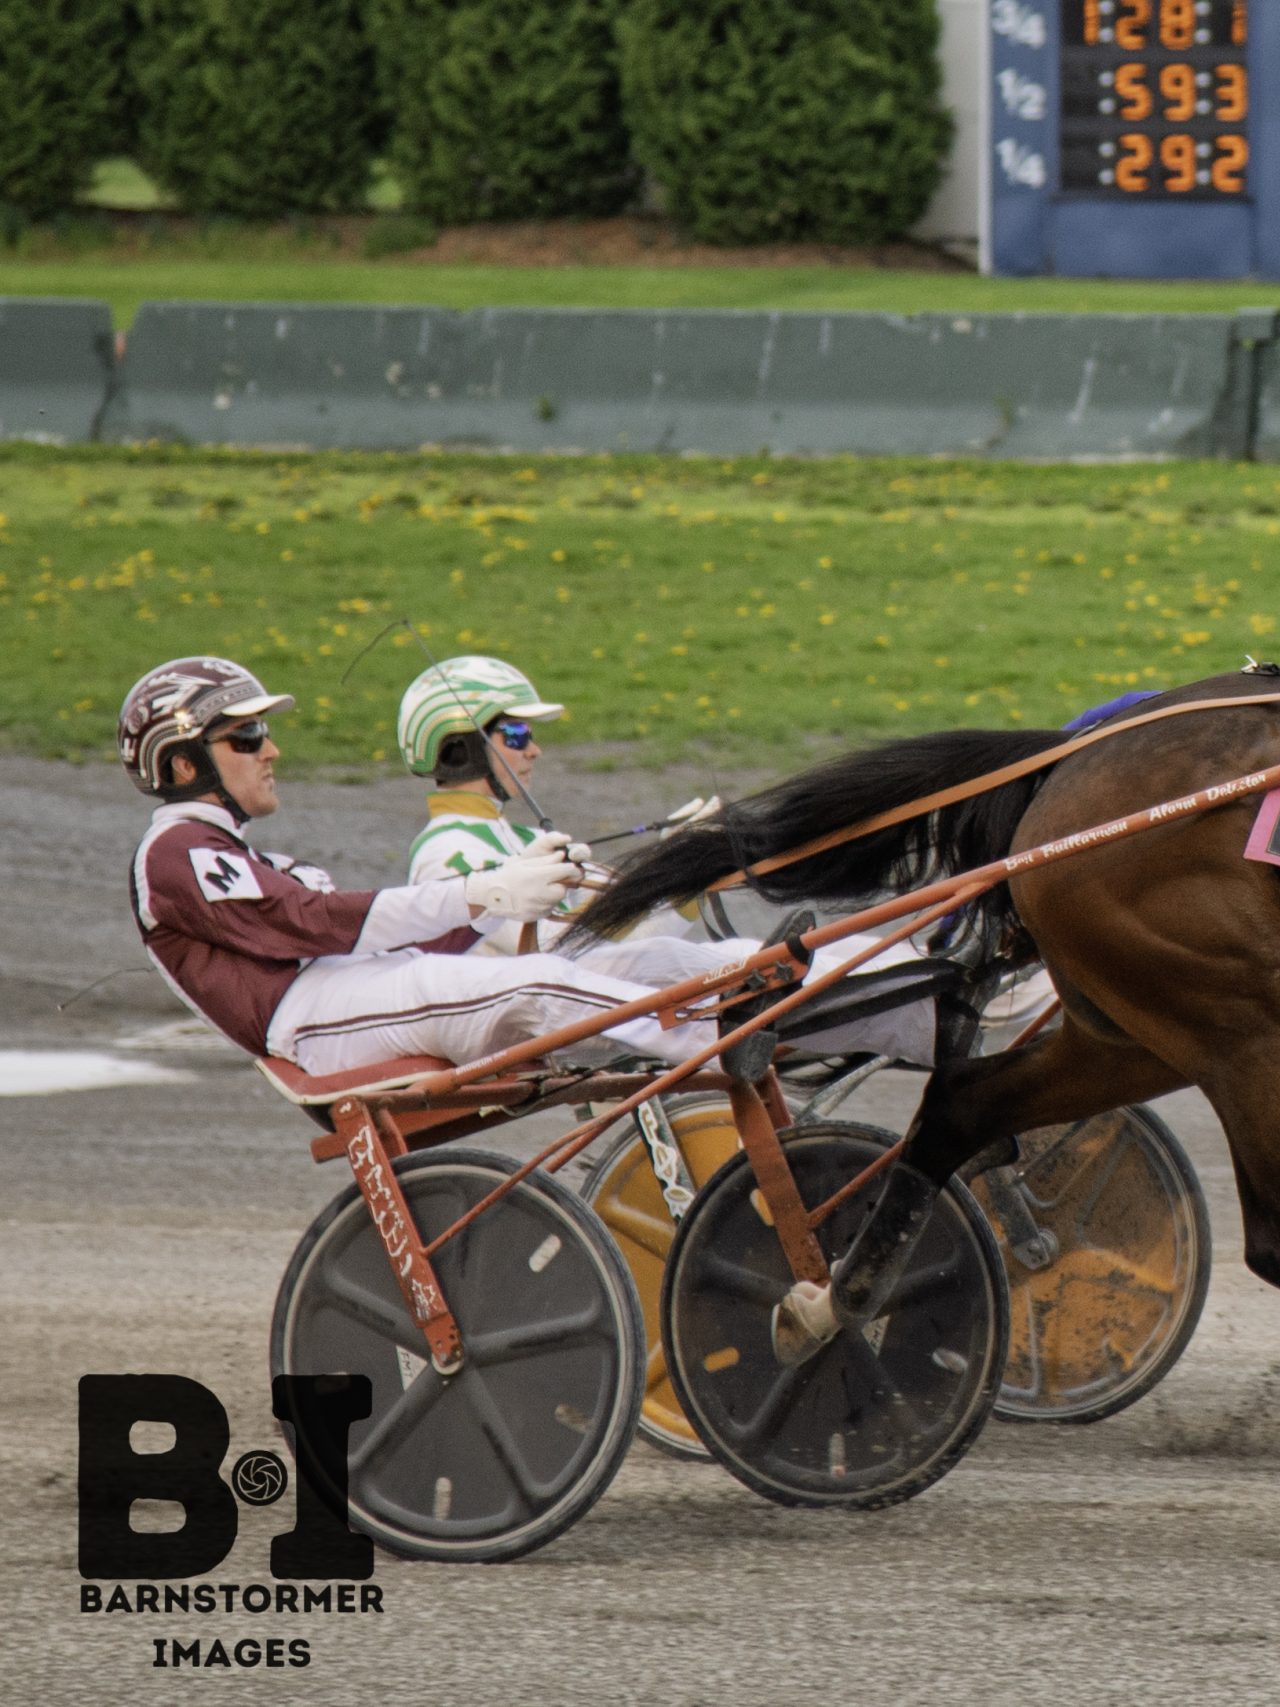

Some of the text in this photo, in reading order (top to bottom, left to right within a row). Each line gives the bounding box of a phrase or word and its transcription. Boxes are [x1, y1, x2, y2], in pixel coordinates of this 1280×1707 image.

[997, 68, 1046, 120] 1/2
[997, 137, 1046, 189] 1/4
[204, 855, 241, 895] M
